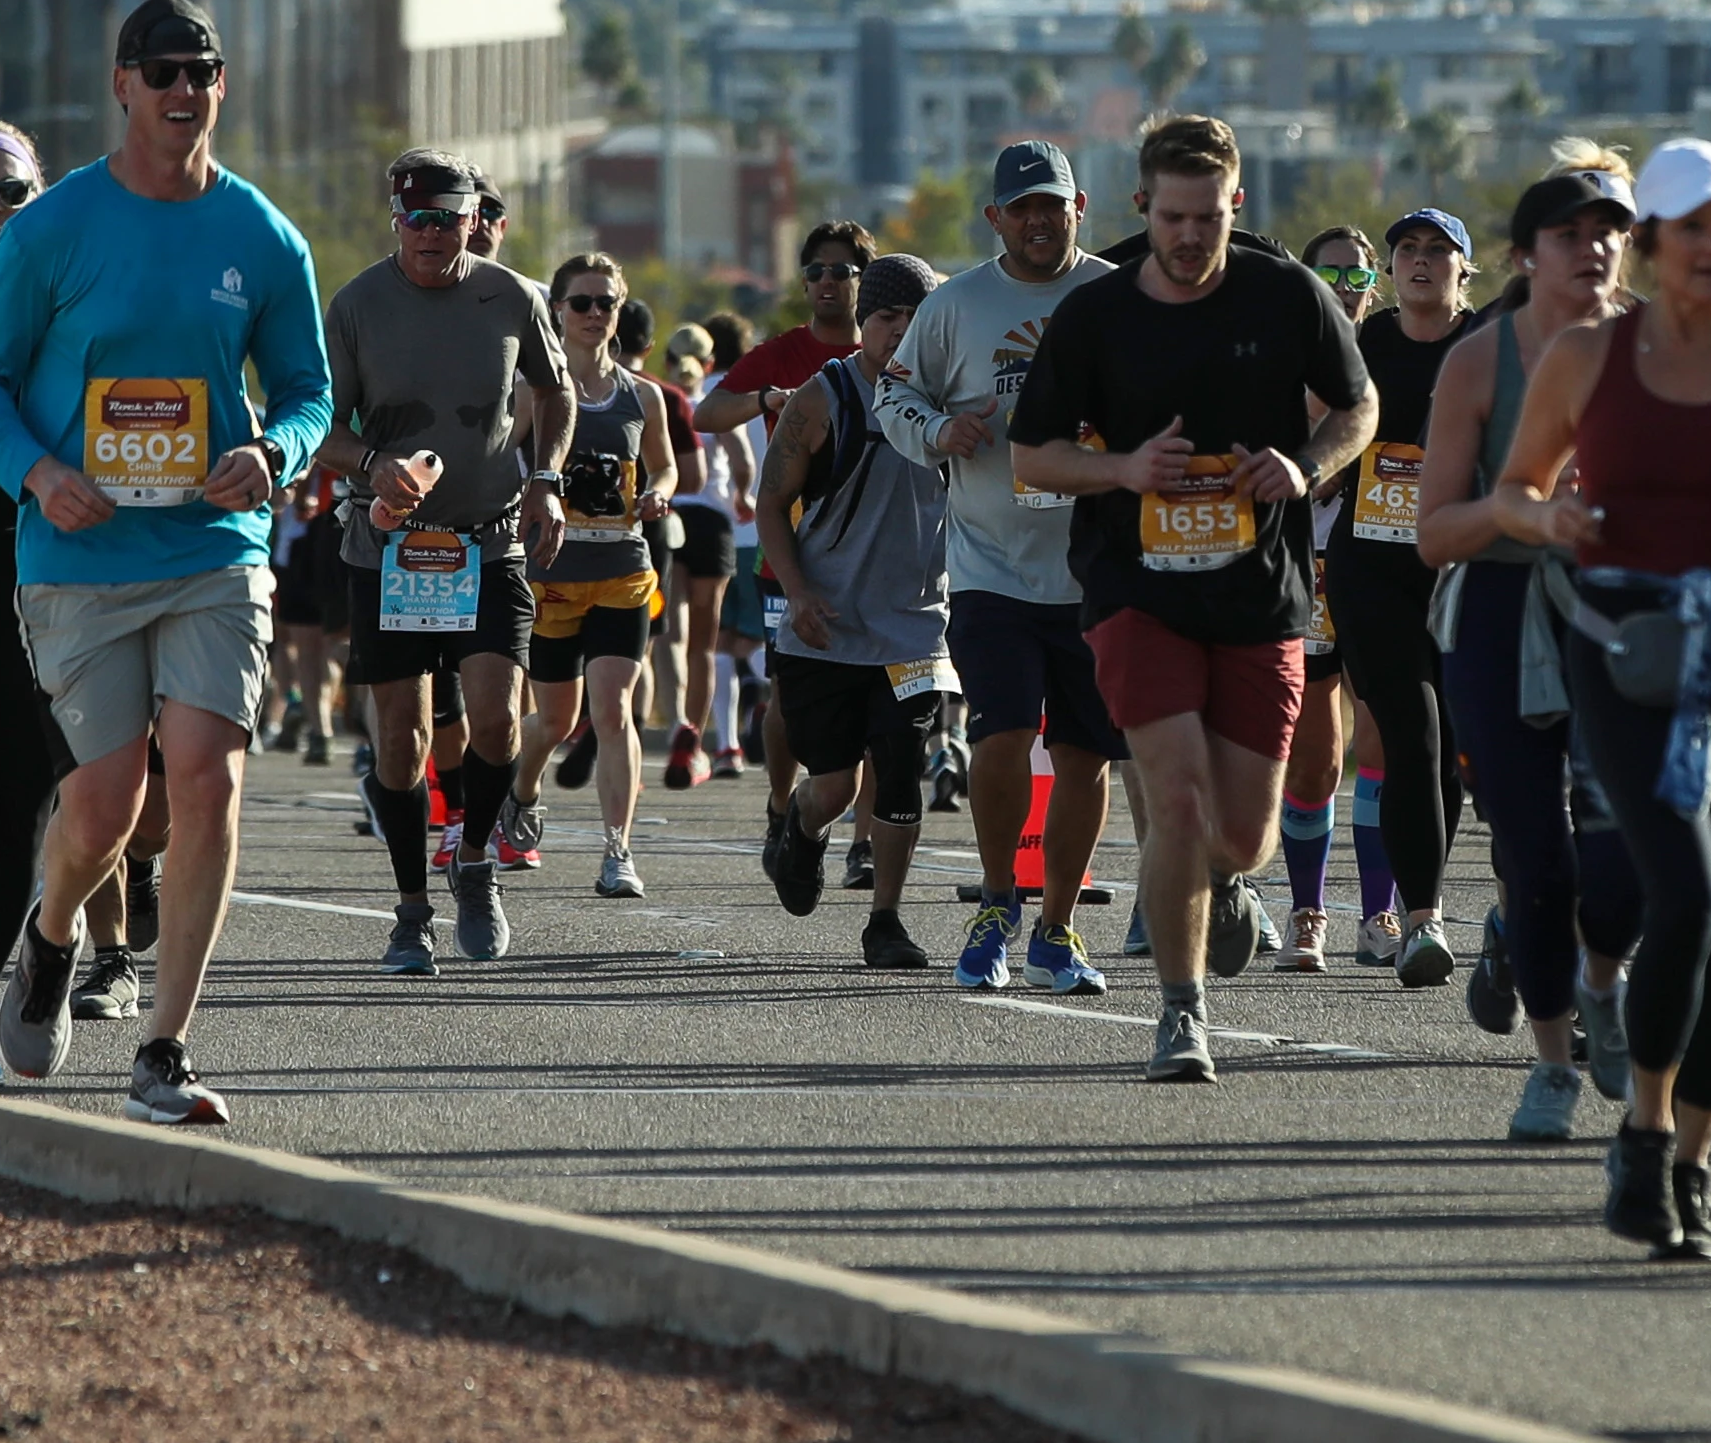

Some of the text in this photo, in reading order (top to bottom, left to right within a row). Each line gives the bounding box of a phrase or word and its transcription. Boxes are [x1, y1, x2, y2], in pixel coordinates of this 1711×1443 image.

[109, 401, 142, 411] Rock
[154, 401, 184, 411] Roll
[95, 433, 196, 463] 6602
[127, 462, 162, 472] CHRIS
[94, 475, 196, 485] HALF MARATHON
[1155, 504, 1237, 533] 1653
[1363, 515, 1387, 524] HALF
[1152, 539, 1246, 553] HALF MARATHON
[386, 573, 476, 597] 21354
[403, 606, 457, 615] MARATHON
[899, 670, 923, 683] HALF
